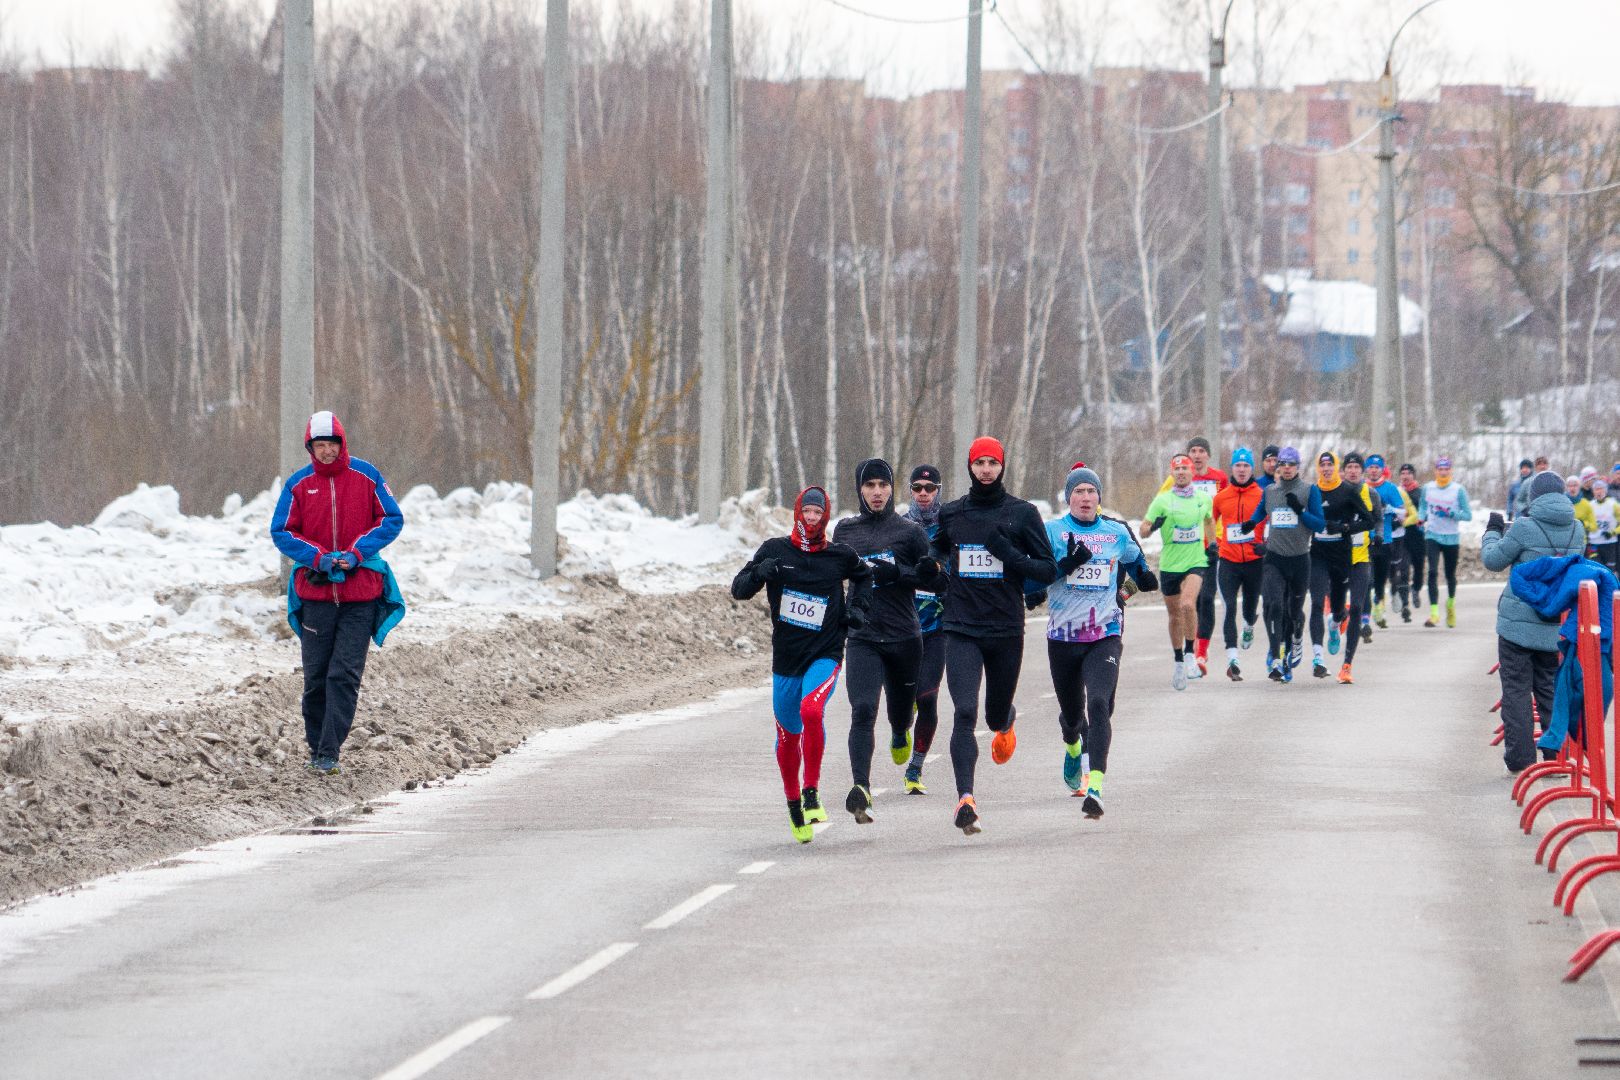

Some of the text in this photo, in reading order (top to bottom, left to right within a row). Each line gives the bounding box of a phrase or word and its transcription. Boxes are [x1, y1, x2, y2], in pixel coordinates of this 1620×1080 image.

[1276, 513, 1291, 521] 225
[1179, 531, 1195, 539] 210
[968, 554, 993, 567] 115
[1077, 567, 1102, 580] 239
[789, 601, 815, 618] 106
